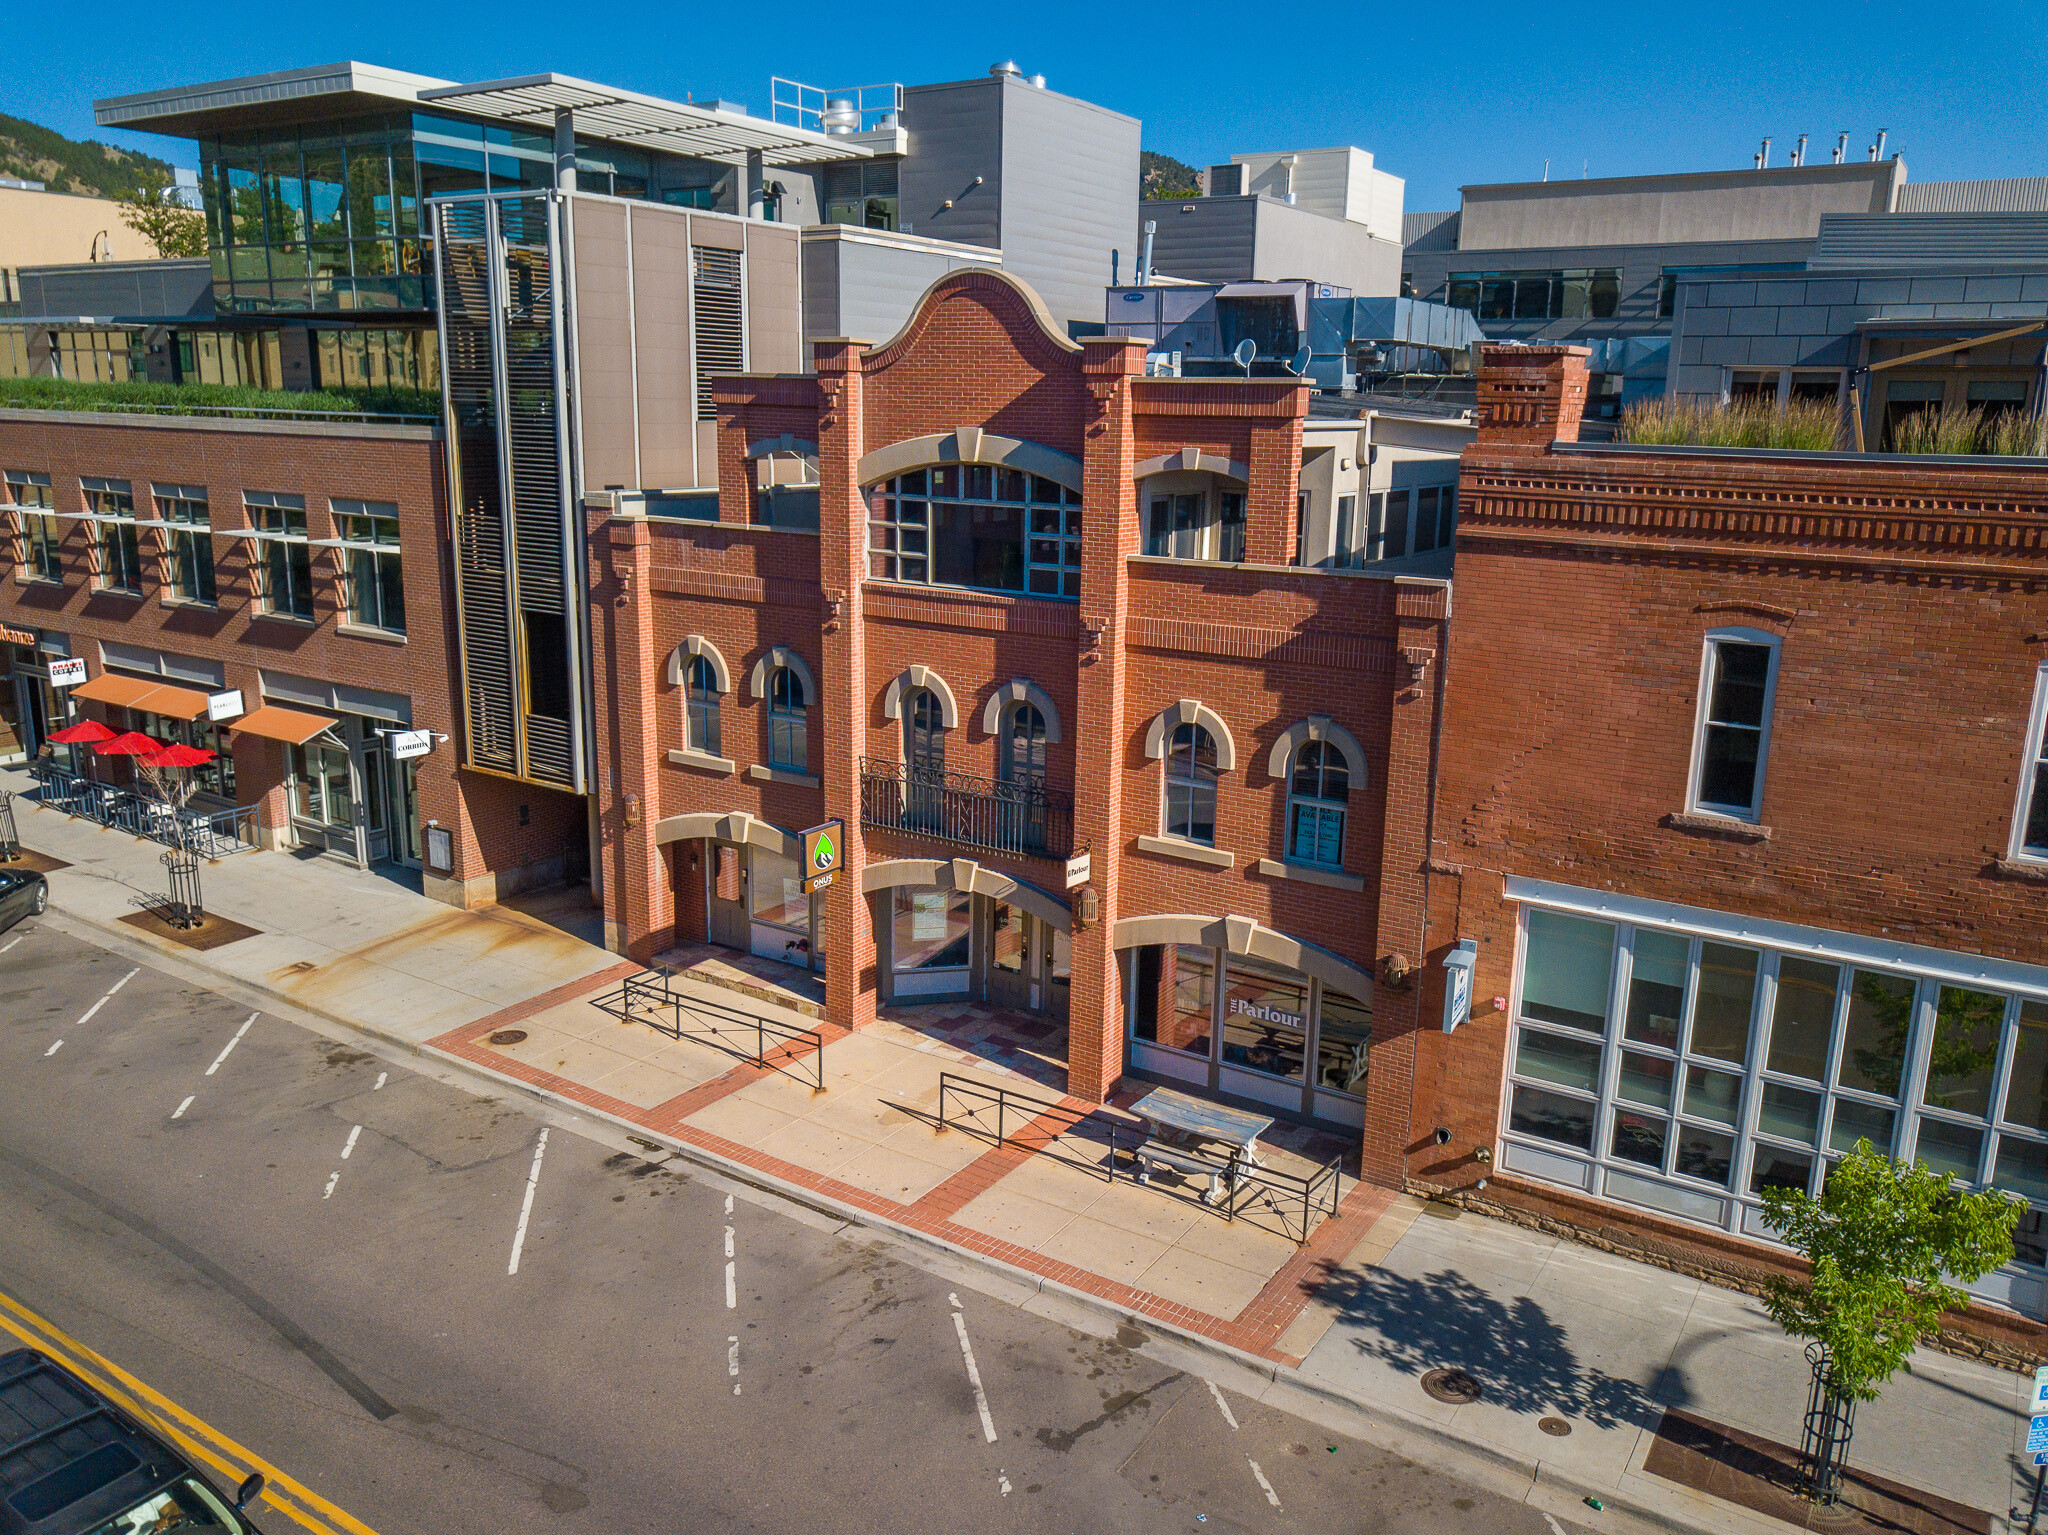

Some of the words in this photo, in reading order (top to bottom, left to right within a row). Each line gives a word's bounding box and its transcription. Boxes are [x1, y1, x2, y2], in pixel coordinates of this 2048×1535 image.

[1301, 811, 1339, 823] AVAABLE
[813, 874, 833, 888] ONUS
[1229, 997, 1238, 1013] THE
[1238, 999, 1301, 1028] Parlour
